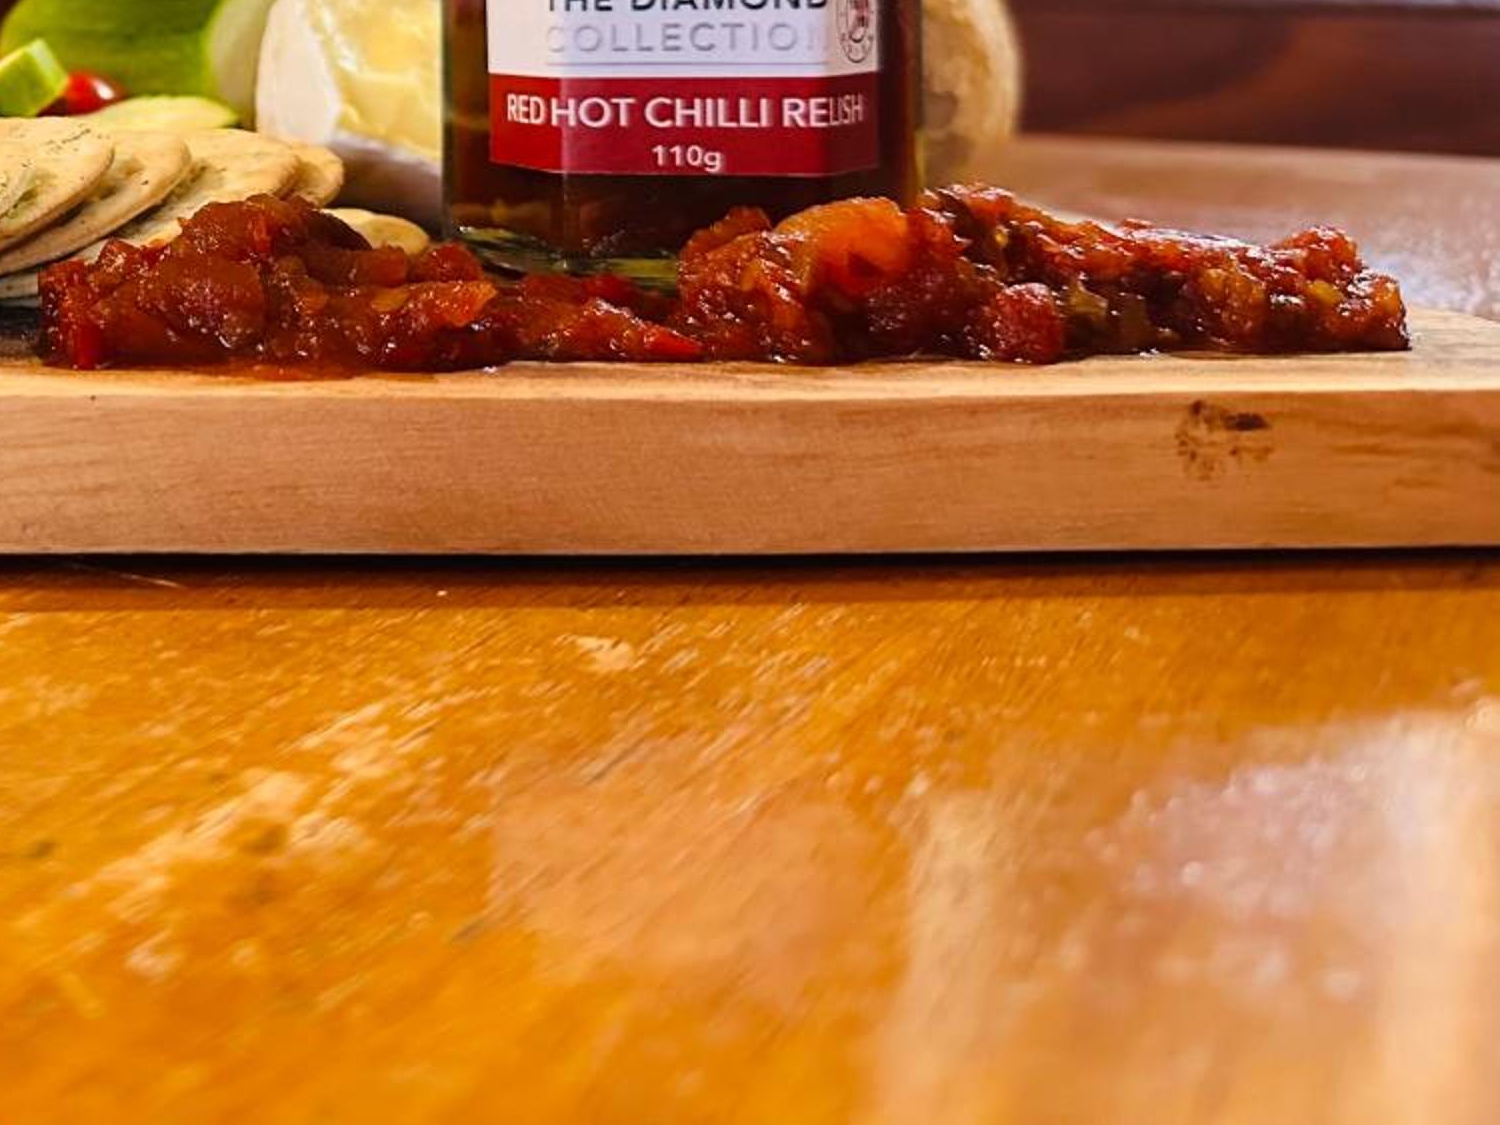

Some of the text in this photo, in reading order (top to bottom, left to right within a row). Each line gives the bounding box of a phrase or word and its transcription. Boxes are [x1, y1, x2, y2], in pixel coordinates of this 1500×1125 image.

[507, 94, 864, 128] RED HOT CHILLI RELISH
[652, 145, 723, 171] 110g
